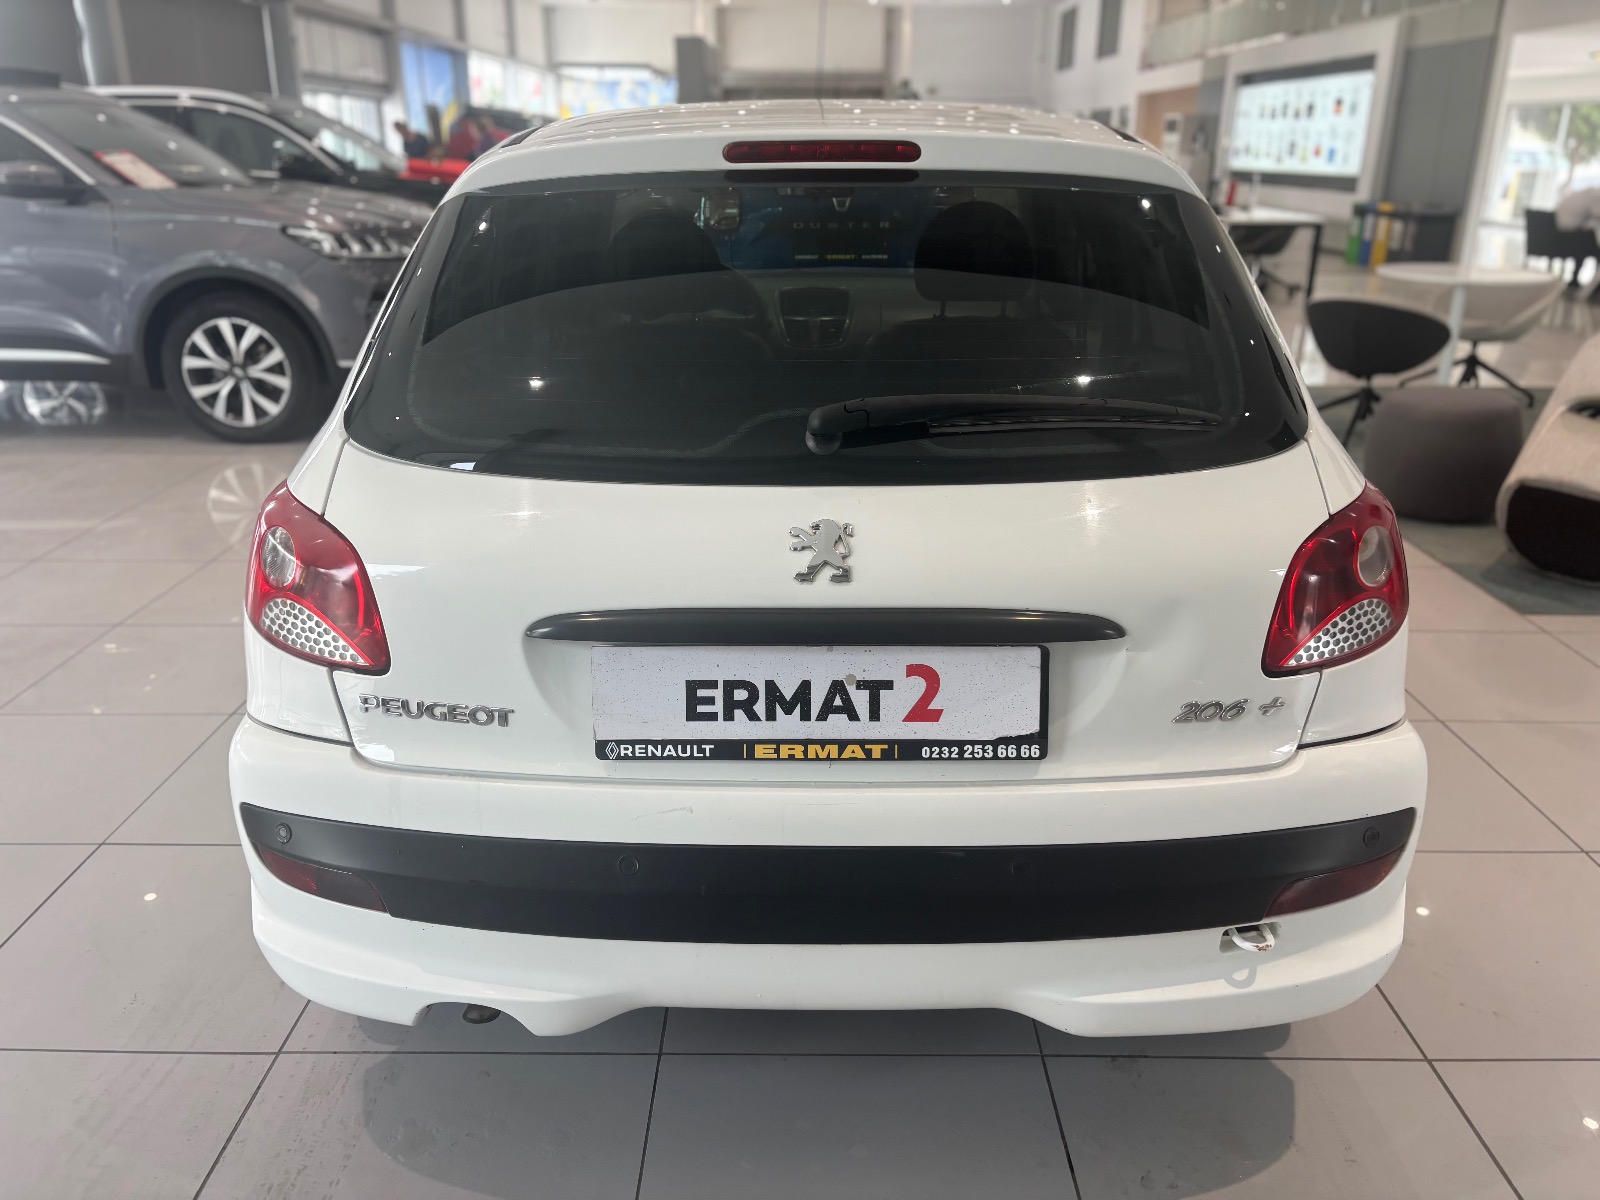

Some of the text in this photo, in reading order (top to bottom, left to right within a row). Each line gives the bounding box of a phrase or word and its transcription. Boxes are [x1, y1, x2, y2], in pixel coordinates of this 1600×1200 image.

[793, 221, 890, 229] DUSTER
[685, 663, 945, 723] ERMAT 2
[358, 693, 515, 727] PEUGEOT
[1171, 699, 1250, 723] 206
[620, 743, 1041, 759] RENAULT ERMAT 0232 253 66 66
